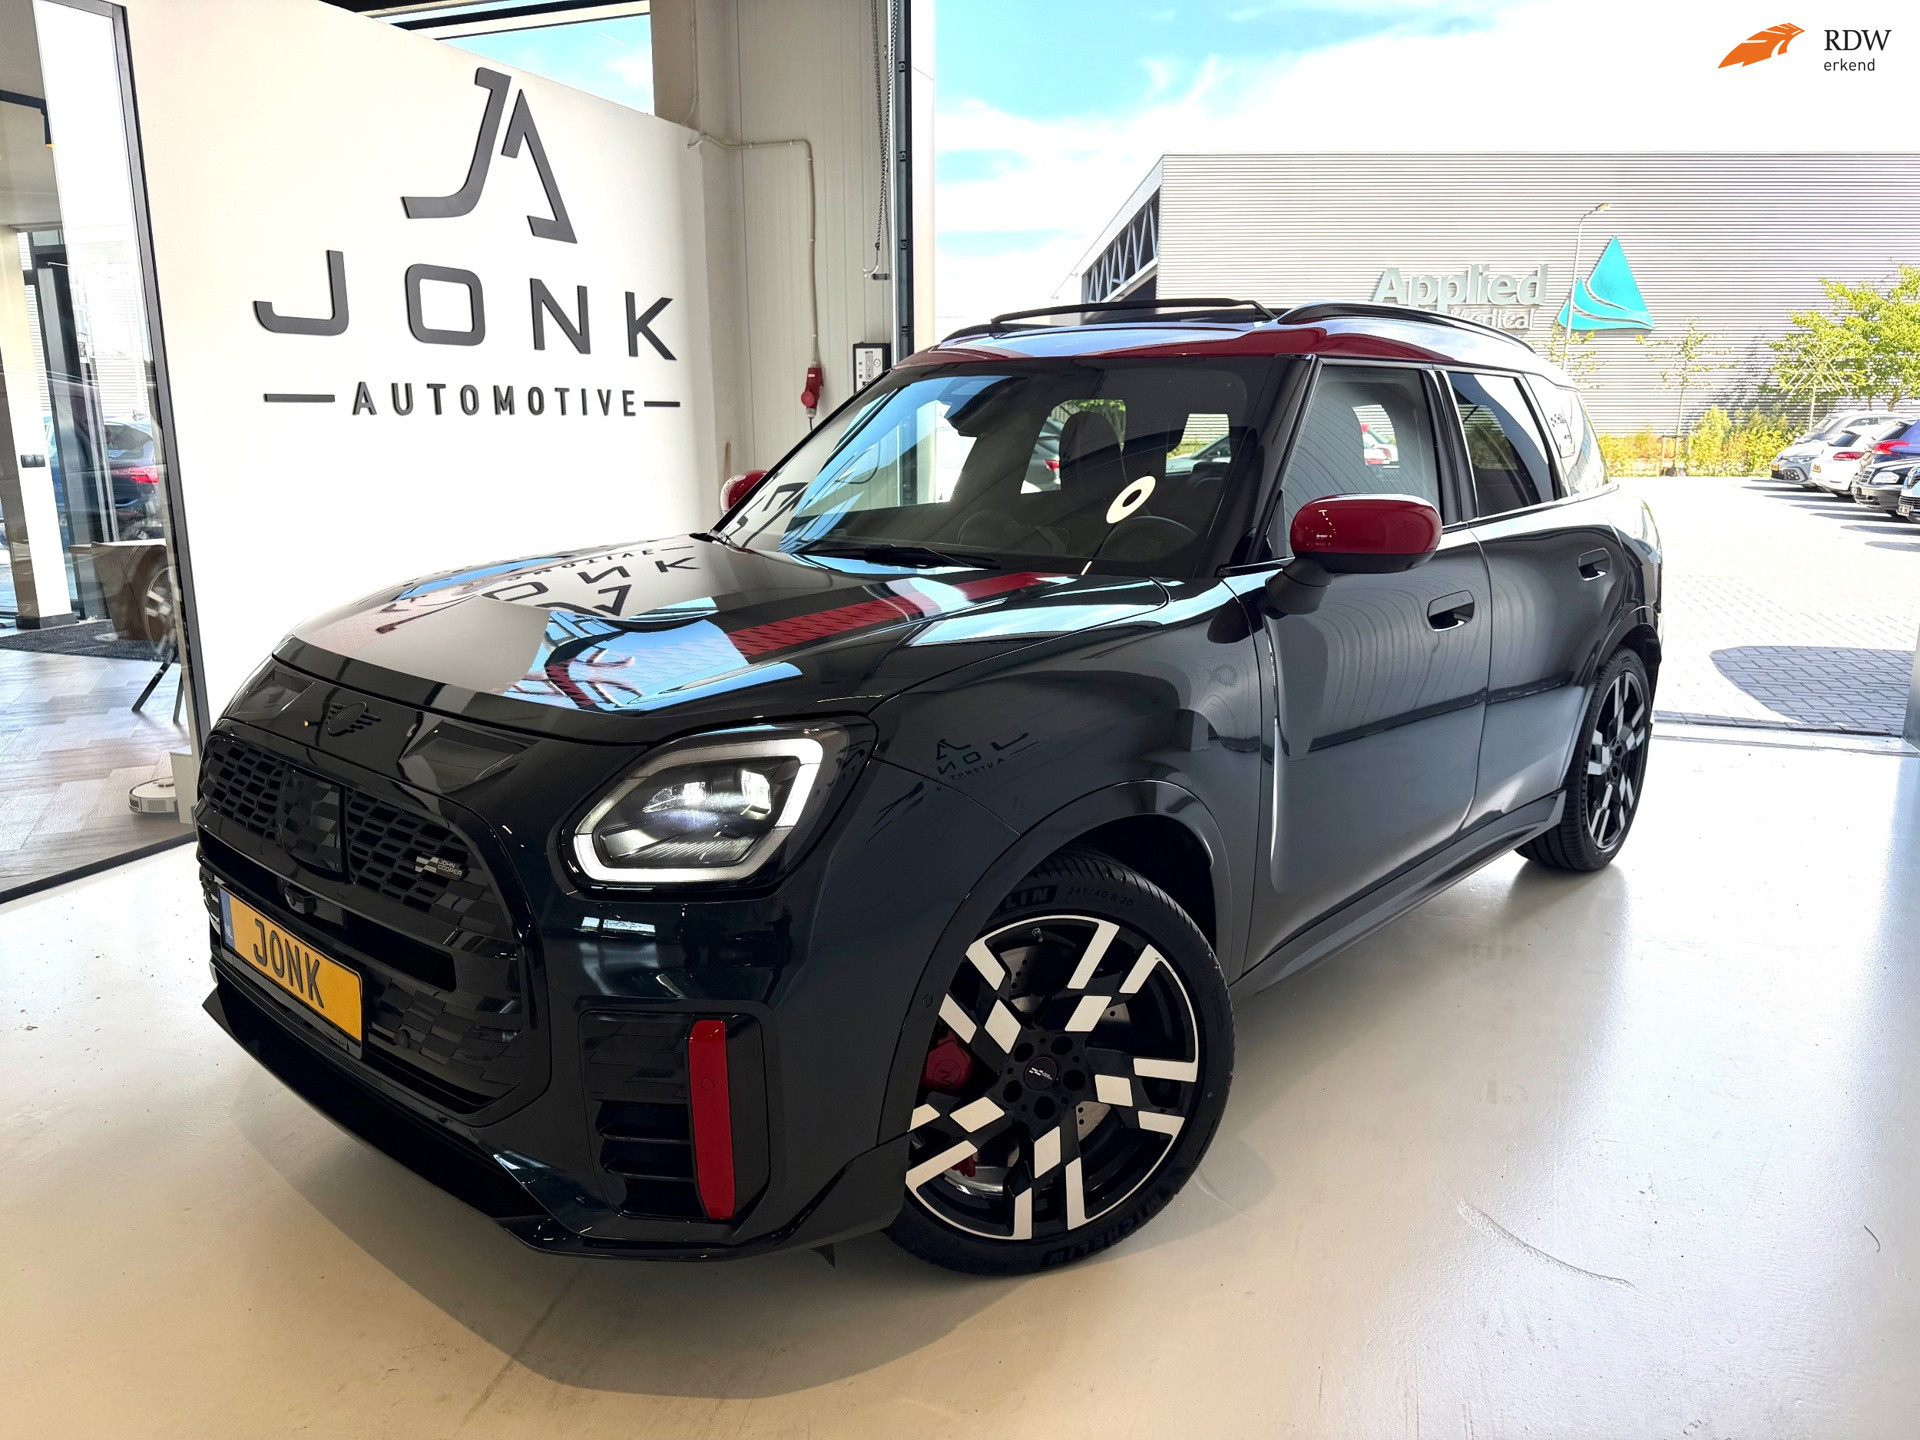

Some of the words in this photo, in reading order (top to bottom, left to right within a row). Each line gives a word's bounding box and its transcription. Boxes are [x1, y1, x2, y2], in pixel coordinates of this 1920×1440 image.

[253, 249, 677, 361] JONK
[1372, 263, 1548, 311] Applied
[352, 381, 636, 417] AUTOMOTIVE
[437, 864, 463, 876] COOPER
[1066, 886, 1108, 899] 245/40
[253, 917, 325, 1009] JONK
